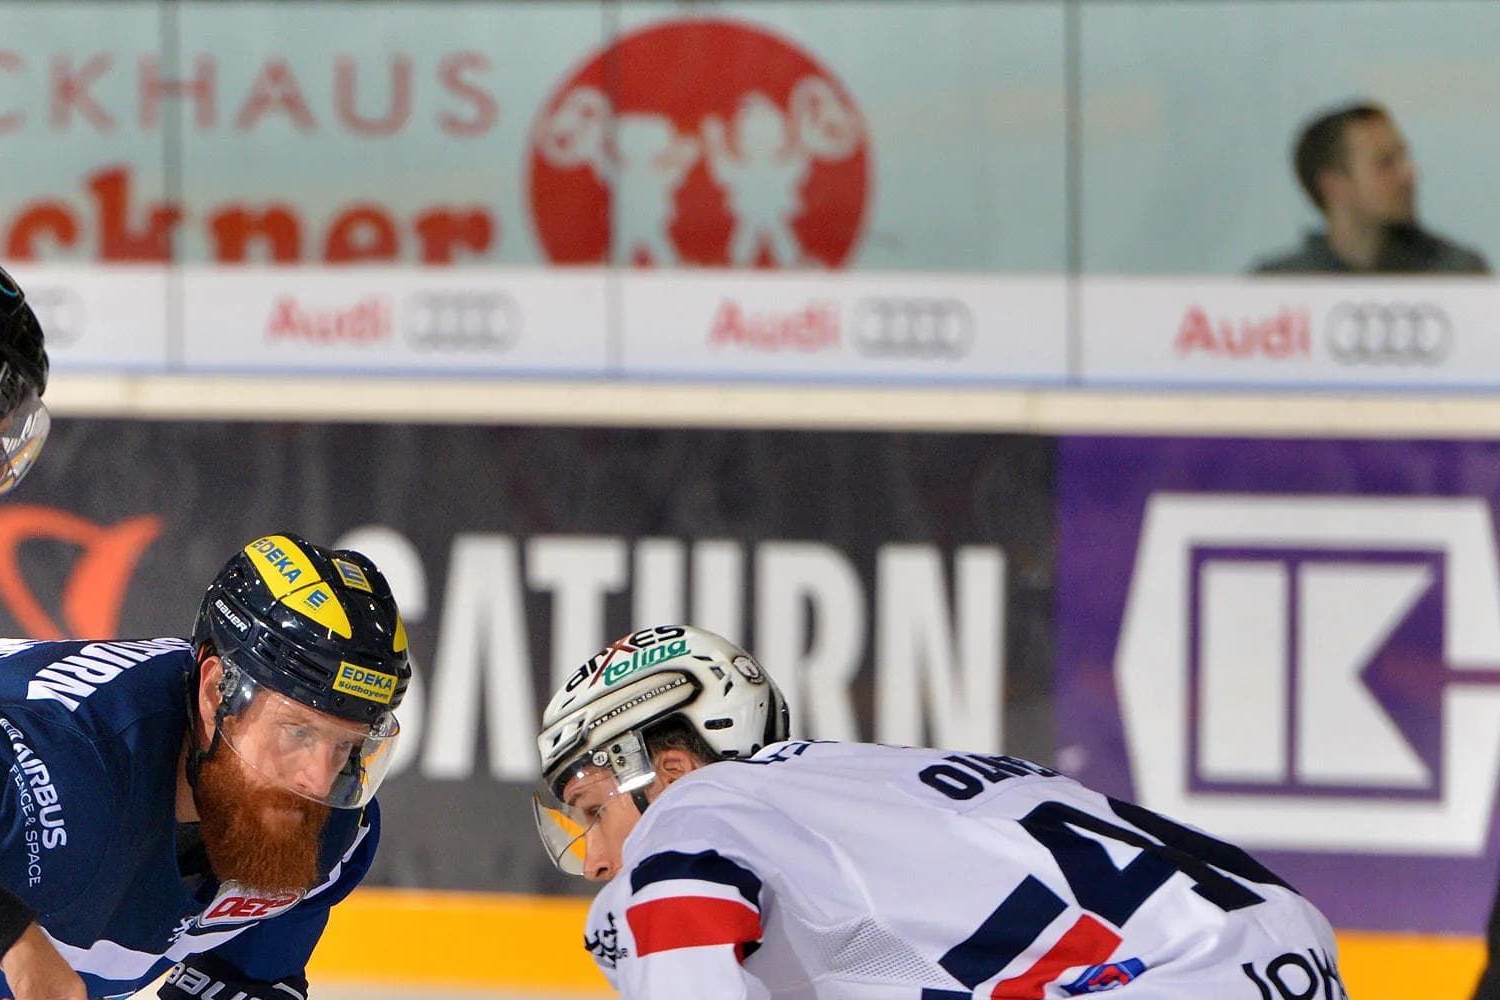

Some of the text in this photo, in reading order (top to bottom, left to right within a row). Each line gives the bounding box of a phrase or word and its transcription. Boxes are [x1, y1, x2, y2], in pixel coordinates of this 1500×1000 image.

[265, 293, 392, 345] Audi
[708, 299, 840, 351] Audi
[1174, 303, 1311, 361] Audi
[252, 538, 303, 584] EDEKA
[341, 666, 393, 691] EDEKA
[603, 638, 692, 687] tolina
[13, 742, 68, 850] AIRBUS
[25, 829, 43, 888] SPACE
